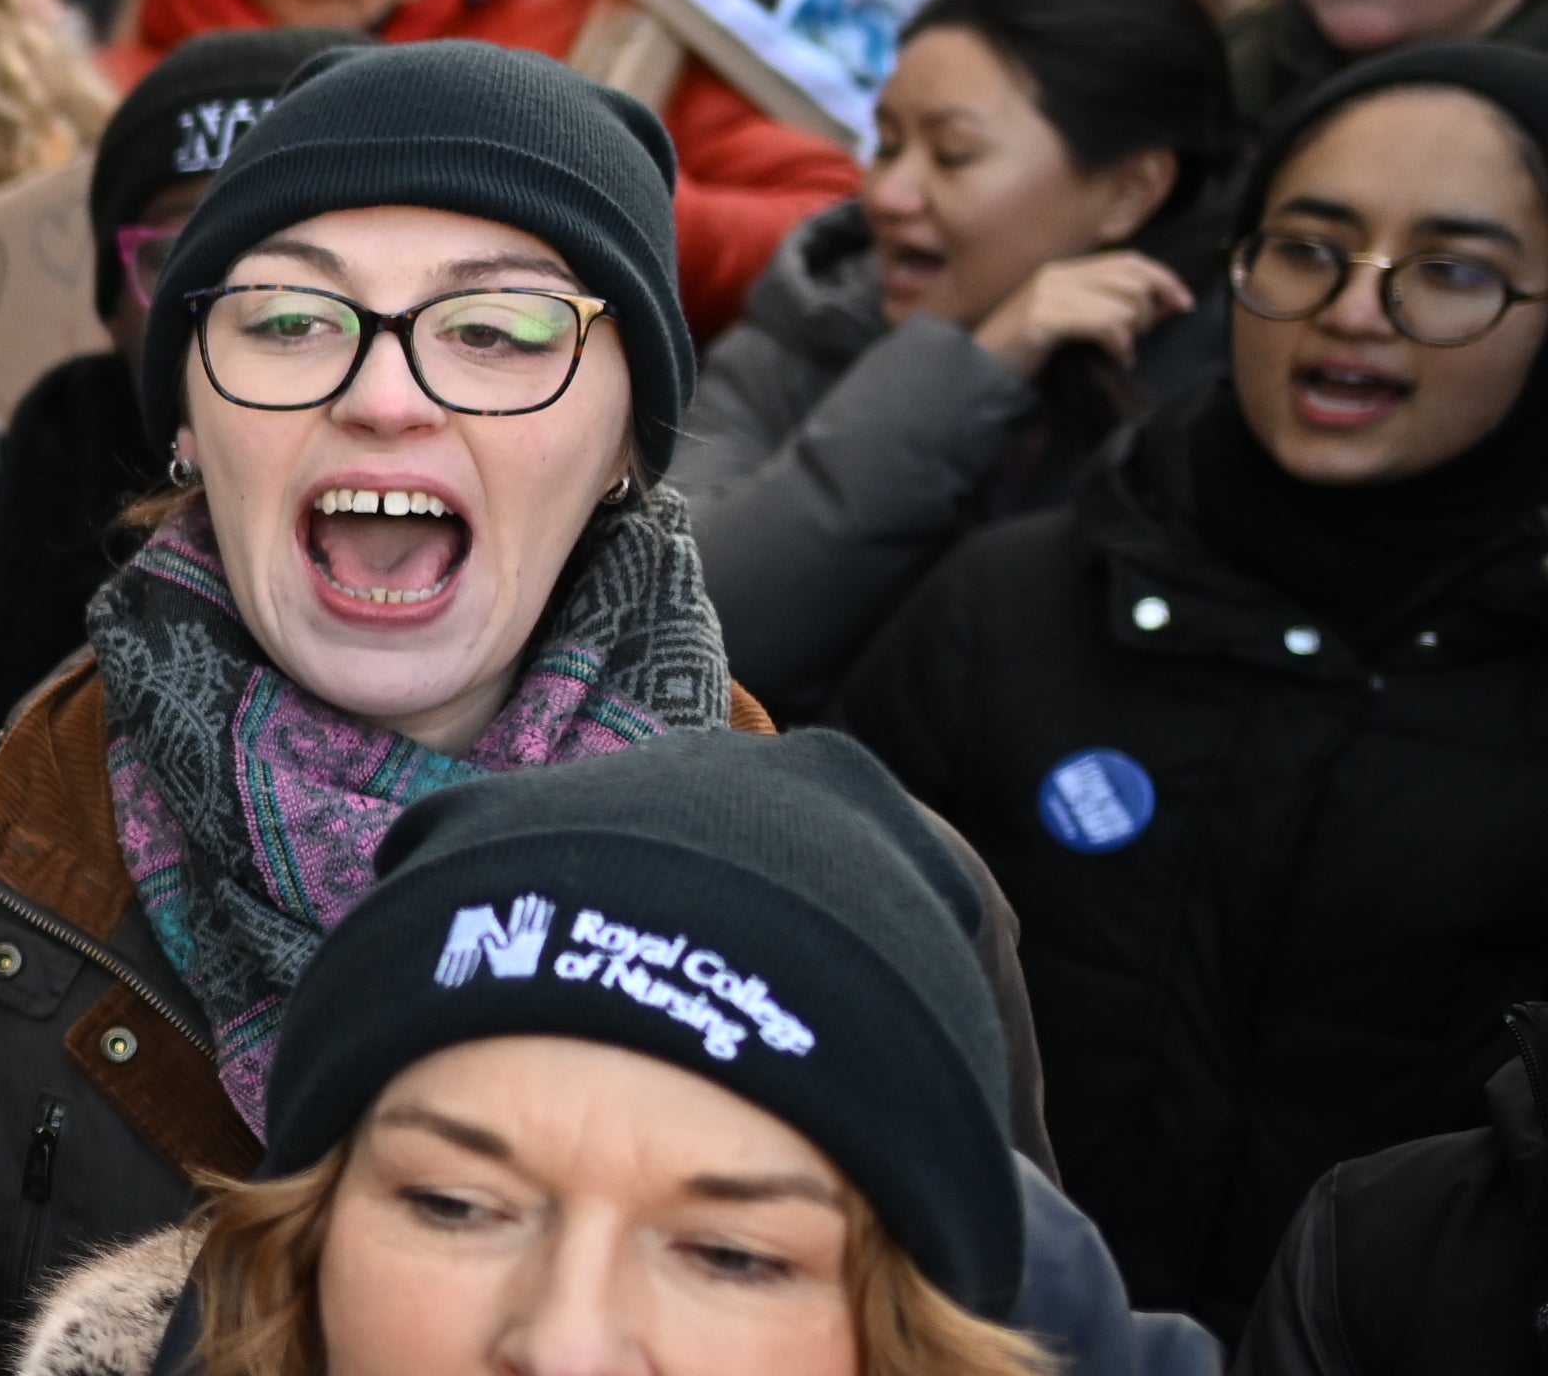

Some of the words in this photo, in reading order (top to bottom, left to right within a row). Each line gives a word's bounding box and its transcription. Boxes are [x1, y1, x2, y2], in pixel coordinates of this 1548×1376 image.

[553, 950, 607, 982] of
[598, 956, 749, 1061] Nursing
[569, 908, 689, 970] Royal
[681, 949, 817, 1058] College
